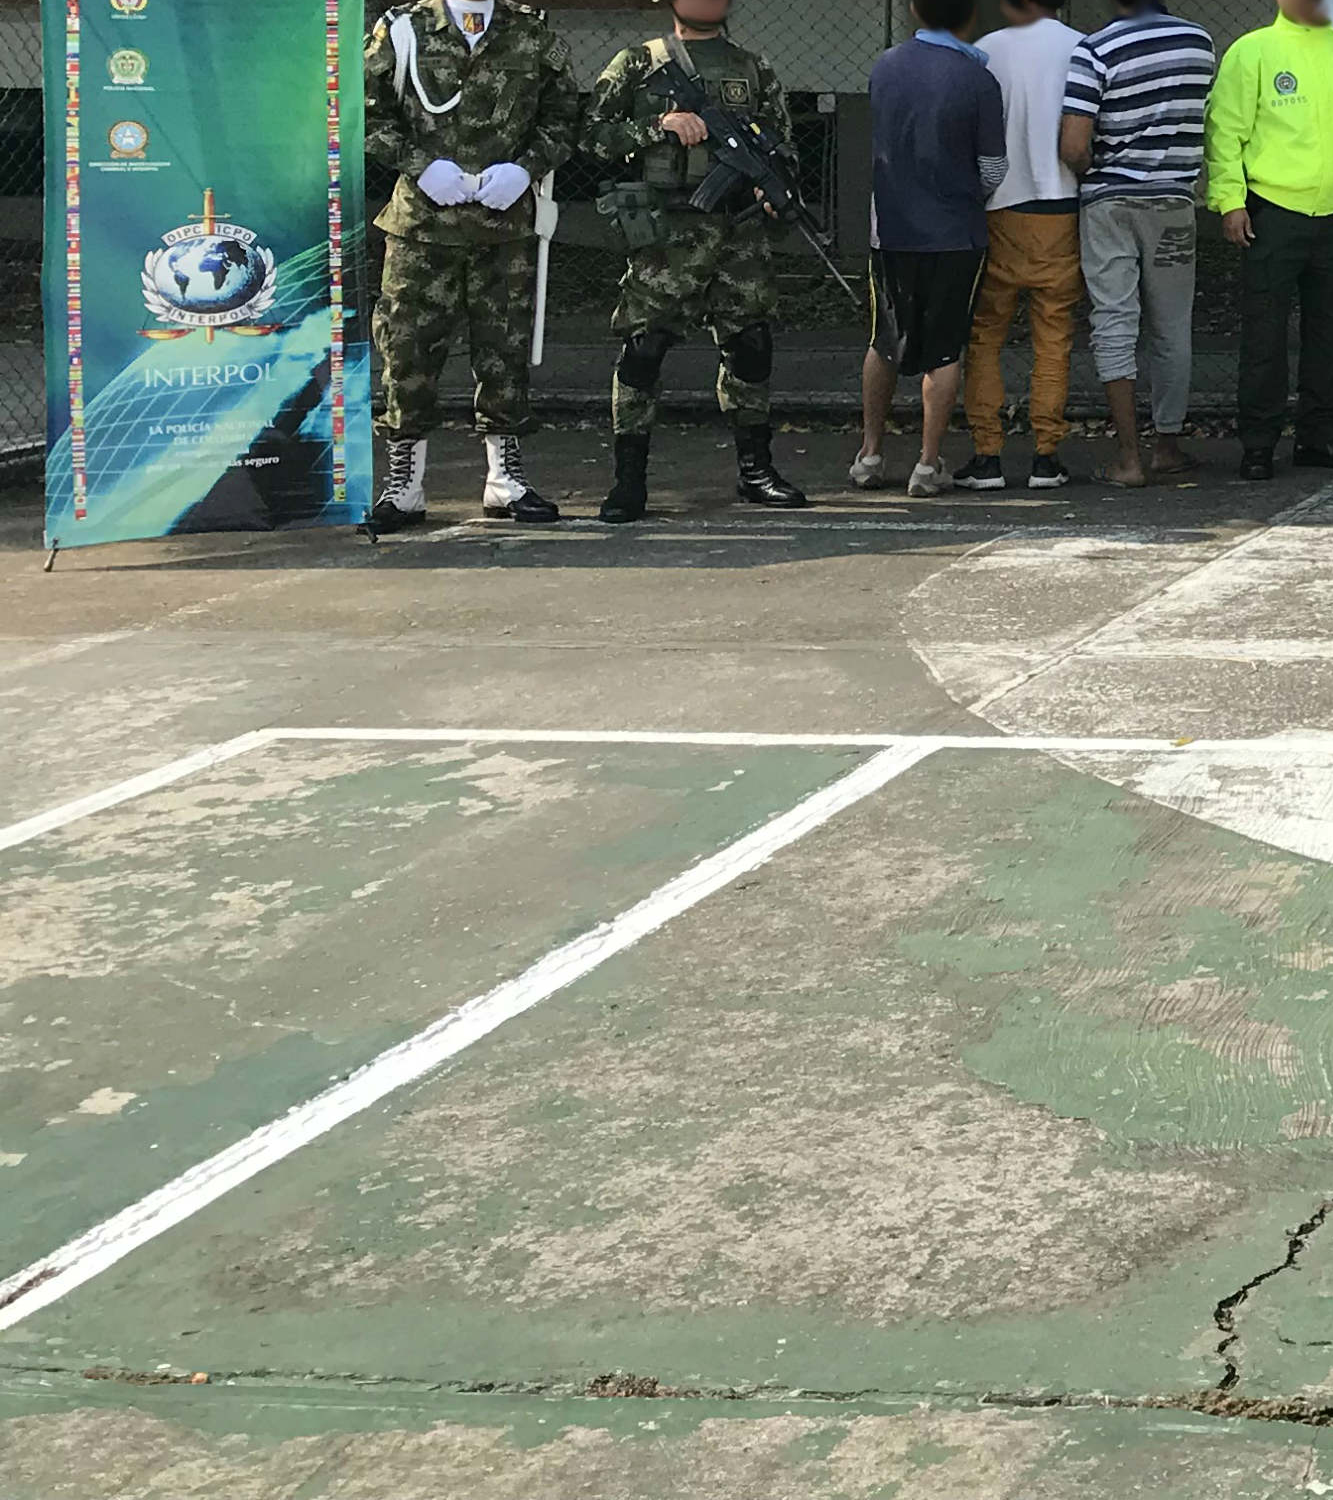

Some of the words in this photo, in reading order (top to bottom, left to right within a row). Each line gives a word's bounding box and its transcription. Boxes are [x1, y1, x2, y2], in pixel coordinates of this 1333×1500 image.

[166, 225, 202, 243] OIPC
[217, 225, 252, 242] ICPO
[170, 305, 250, 324] INTERPOL
[144, 362, 277, 388] INTERPOL
[149, 426, 163, 435] LA
[166, 421, 210, 434] POLICÍA
[173, 436, 189, 445] DE
[244, 456, 280, 468] seguro
